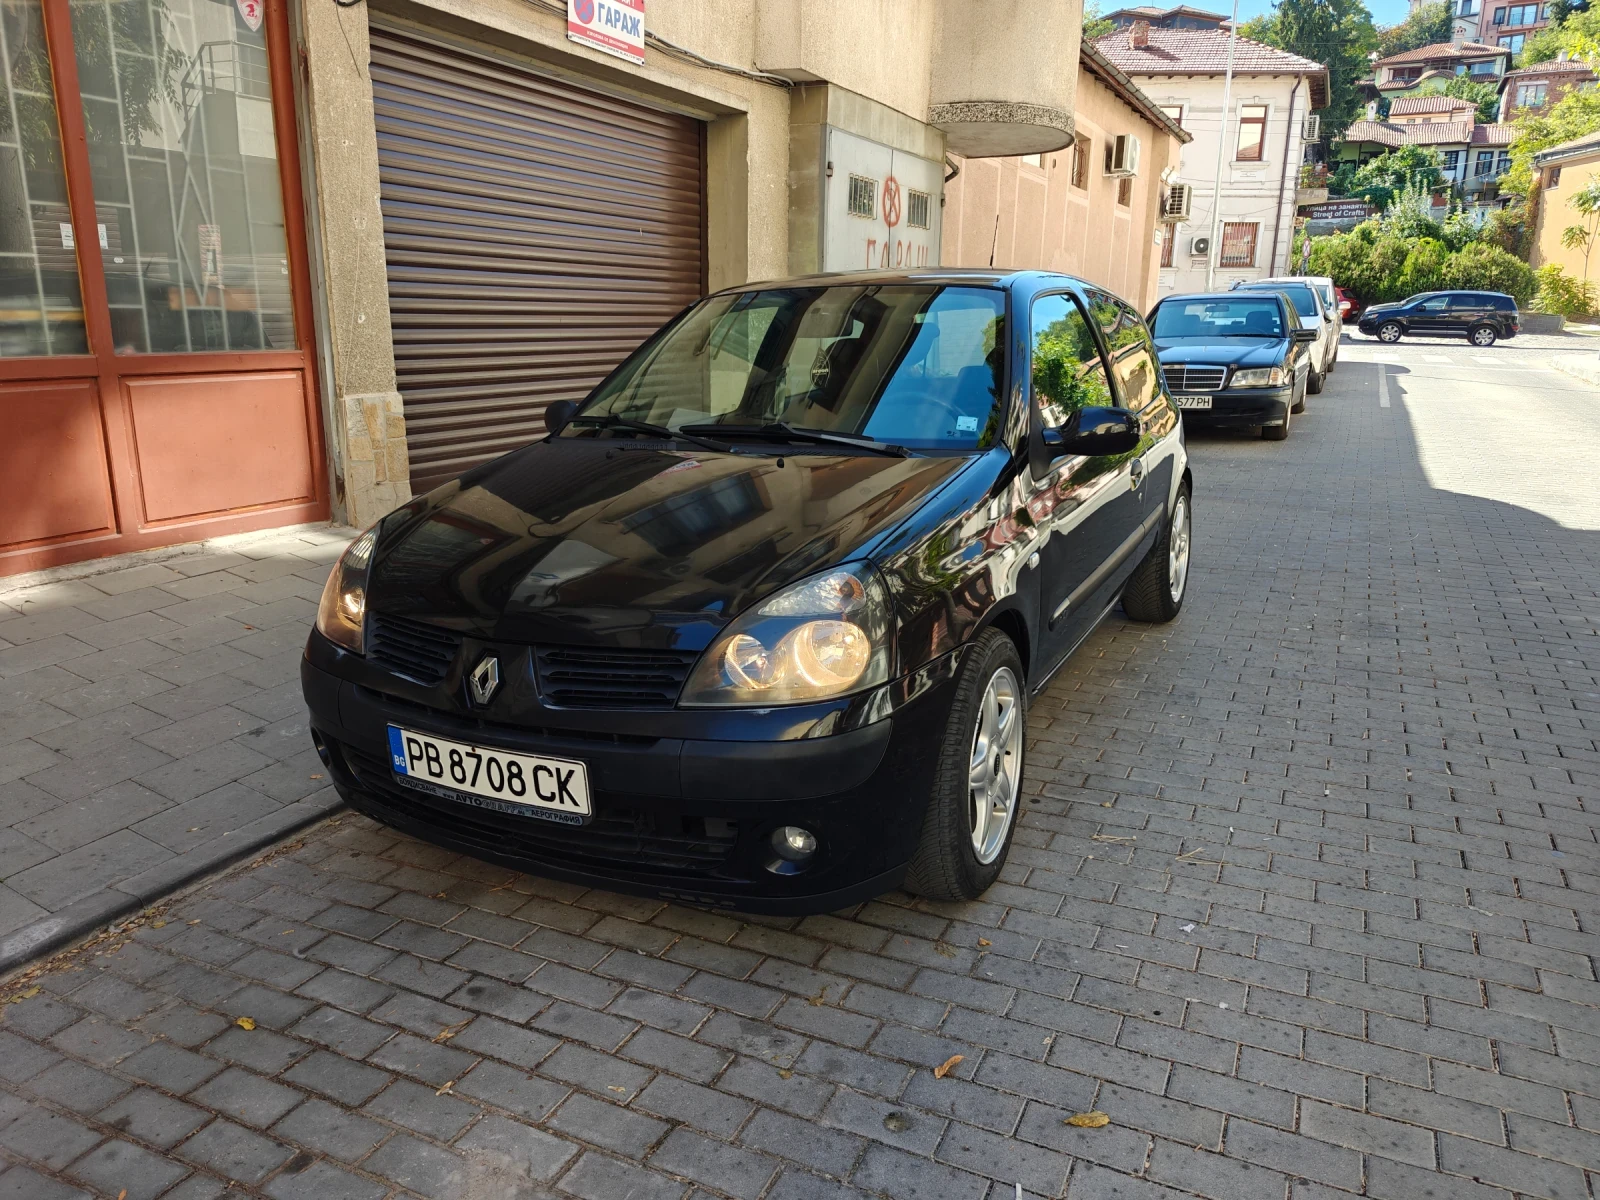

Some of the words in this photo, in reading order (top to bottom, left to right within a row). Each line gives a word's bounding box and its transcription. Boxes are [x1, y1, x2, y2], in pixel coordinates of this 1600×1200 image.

[598, 2, 641, 38] ГАРАЖ
[1196, 397, 1210, 407] PH
[393, 754, 406, 767] BG
[405, 736, 444, 778] PB
[449, 748, 527, 797] 8708
[532, 764, 581, 807] CK
[531, 809, 581, 825] АЕРОГРАФИЯ
